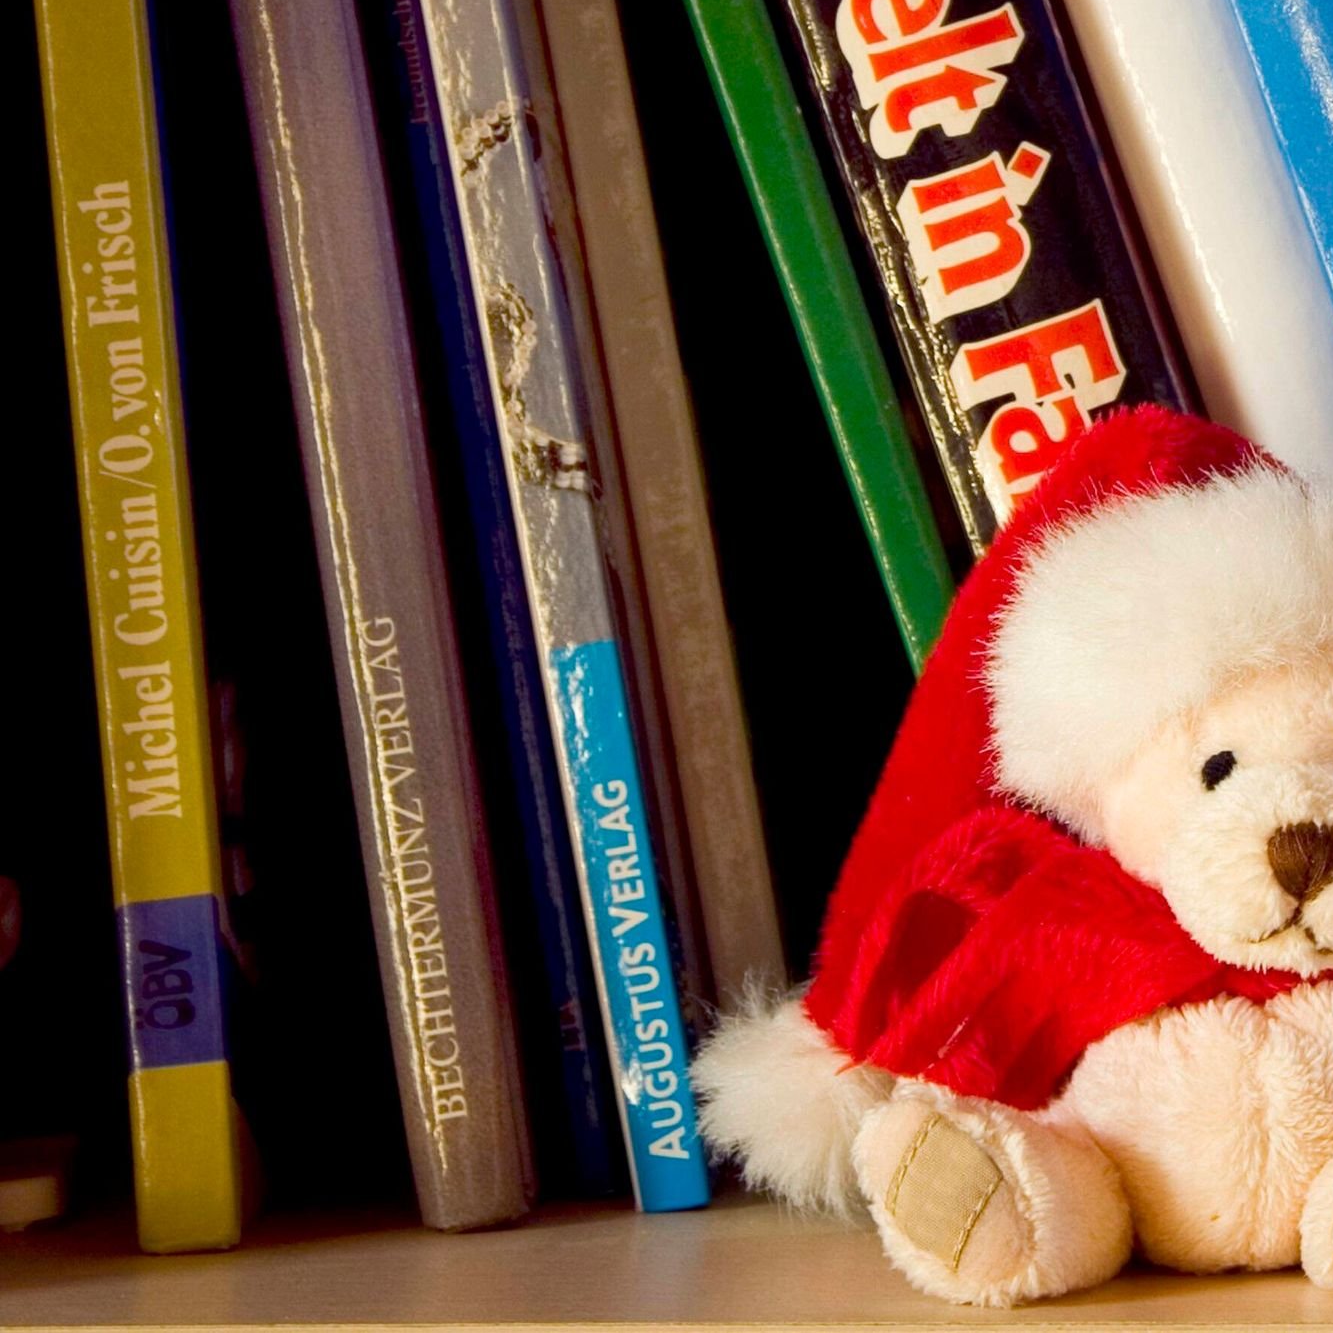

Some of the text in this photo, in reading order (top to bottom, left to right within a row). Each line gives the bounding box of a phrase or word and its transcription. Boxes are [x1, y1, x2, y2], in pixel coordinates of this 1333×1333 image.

[80, 179, 140, 329] Frisch
[895, 140, 1050, 325] in
[109, 339, 149, 413] von
[950, 298, 1128, 509] Fa
[128, 661, 183, 821] Michel
[363, 614, 418, 779] VERLAG
[136, 938, 196, 1032] ÖBV
[600, 779, 690, 1159] AUGUSTUS VERLAG
